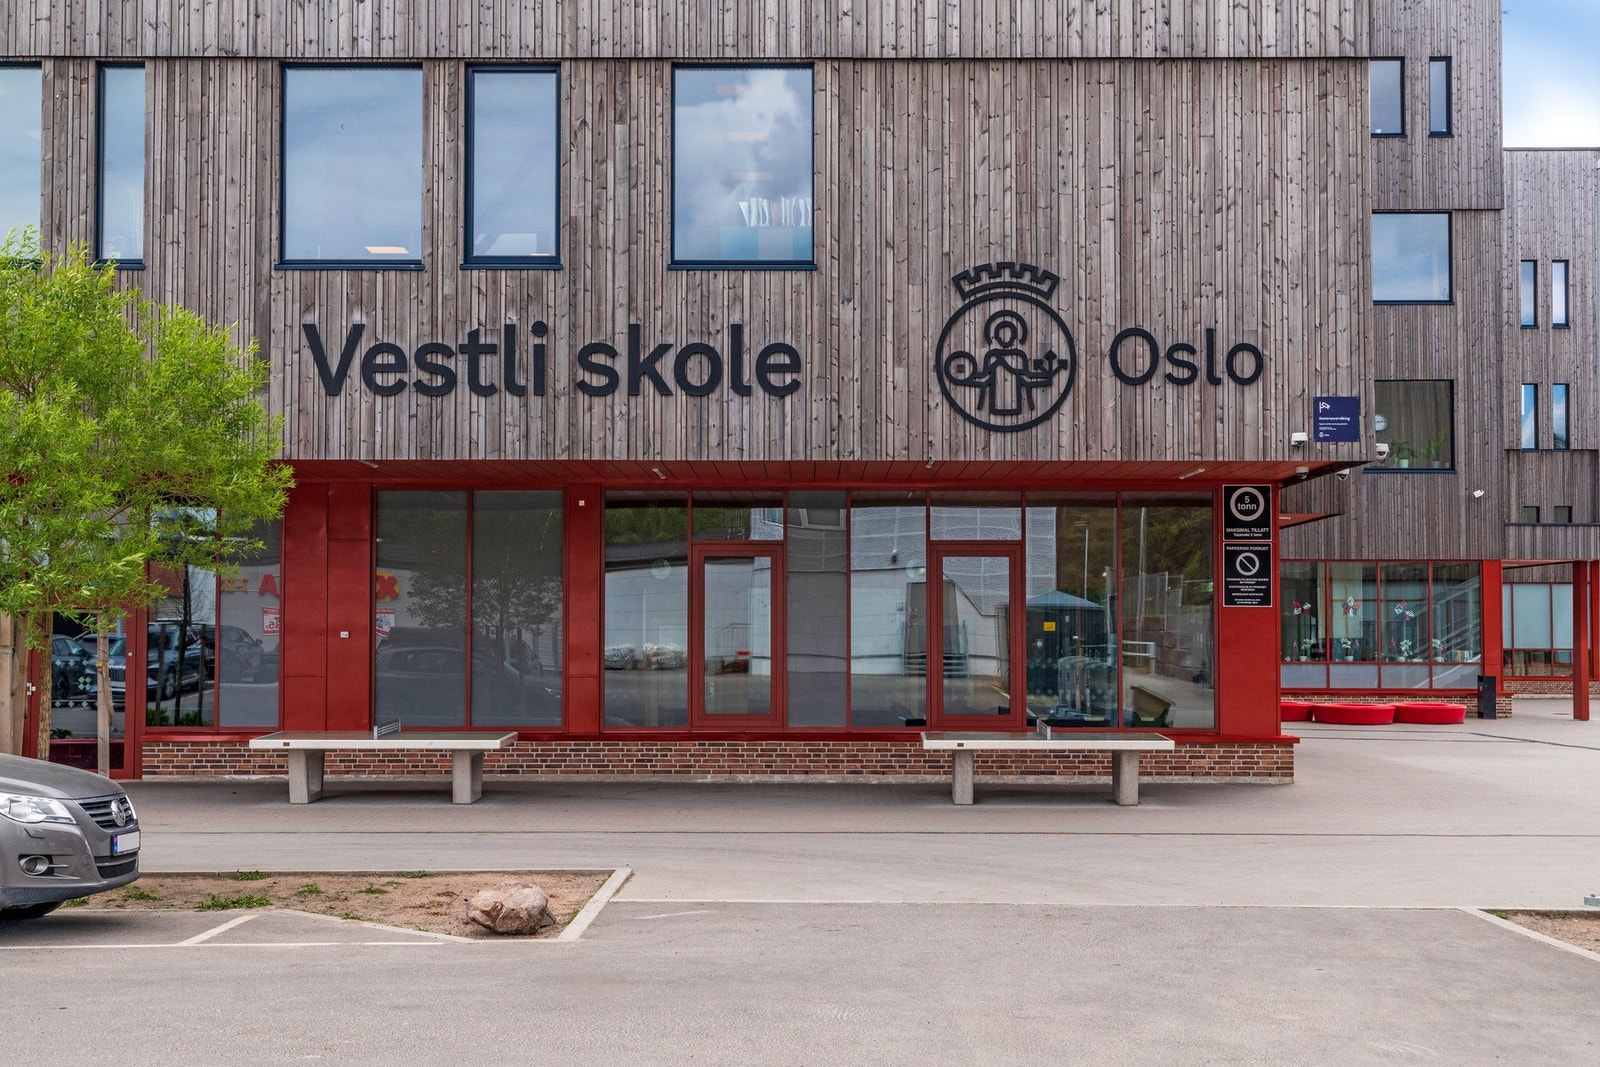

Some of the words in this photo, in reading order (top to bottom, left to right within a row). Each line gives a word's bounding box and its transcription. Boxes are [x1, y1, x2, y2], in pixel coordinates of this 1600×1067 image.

[302, 320, 549, 397] Vestli
[576, 323, 802, 397] skole
[1109, 327, 1265, 387] Oslo
[1244, 495, 1250, 503] 5
